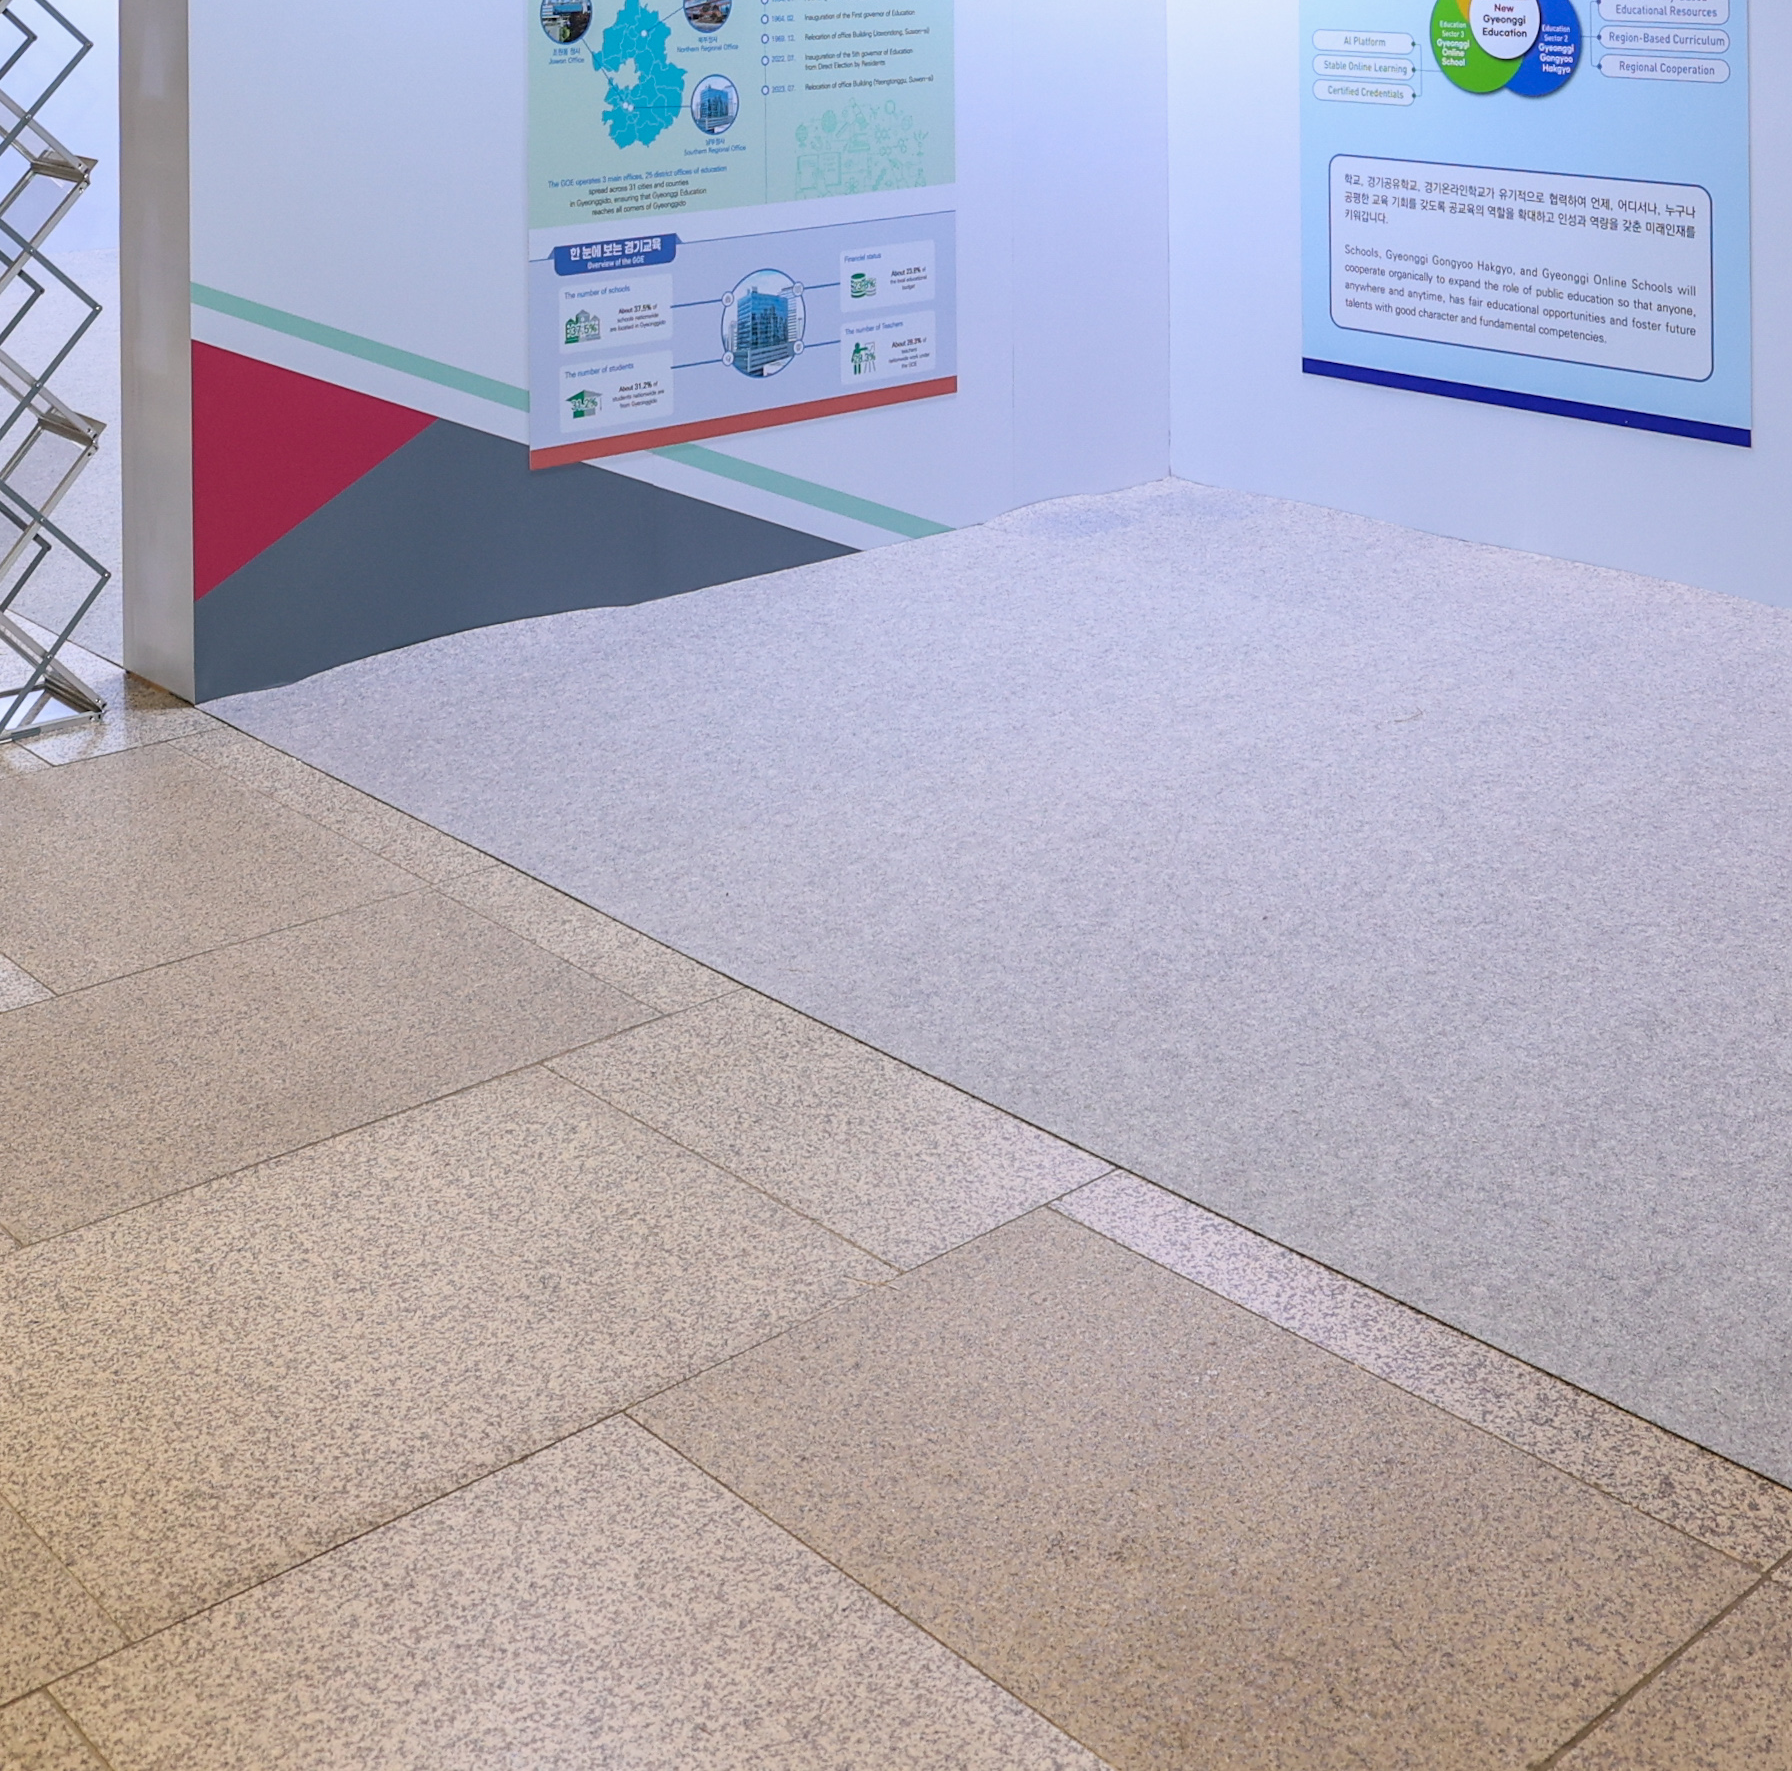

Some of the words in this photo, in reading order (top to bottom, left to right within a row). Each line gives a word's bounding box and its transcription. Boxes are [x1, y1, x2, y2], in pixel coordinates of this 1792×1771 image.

[1494, 3, 1514, 13] New
[1615, 4, 1668, 16] Educational
[1669, 5, 1718, 18] Resources
[1482, 14, 1526, 27] Gyeonggi
[1482, 27, 1528, 38] Education
[1608, 31, 1671, 45] Region-Based
[1672, 32, 1728, 46] Curriculum
[1619, 60, 1658, 74] Regional
[1659, 62, 1715, 76] Cooperation
[571, 247, 580, 261] 한
[582, 245, 602, 260] 눈에
[604, 242, 623, 256] 보는
[625, 238, 661, 254] 경기교육
